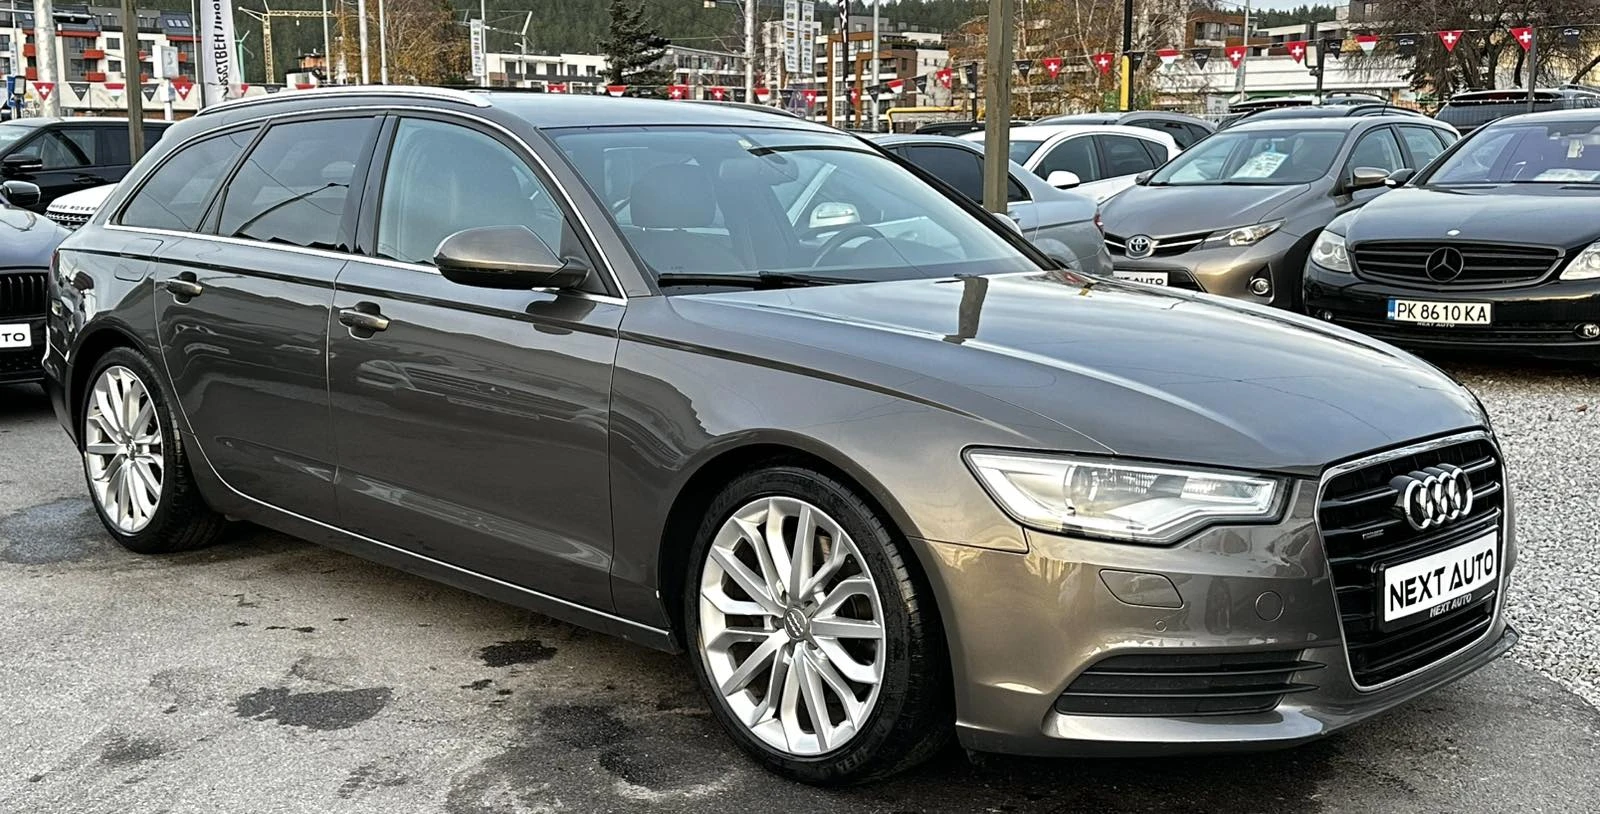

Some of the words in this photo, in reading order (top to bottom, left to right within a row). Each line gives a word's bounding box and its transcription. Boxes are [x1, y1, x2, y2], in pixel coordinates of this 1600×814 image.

[1397, 303, 1417, 319] PK
[1420, 304, 1461, 321] 8610
[1465, 305, 1488, 322] KA
[1390, 566, 1446, 612] NEXT
[1448, 548, 1494, 591] AUTO
[1429, 601, 1452, 618] NEXT
[1450, 593, 1473, 611] AUTO
